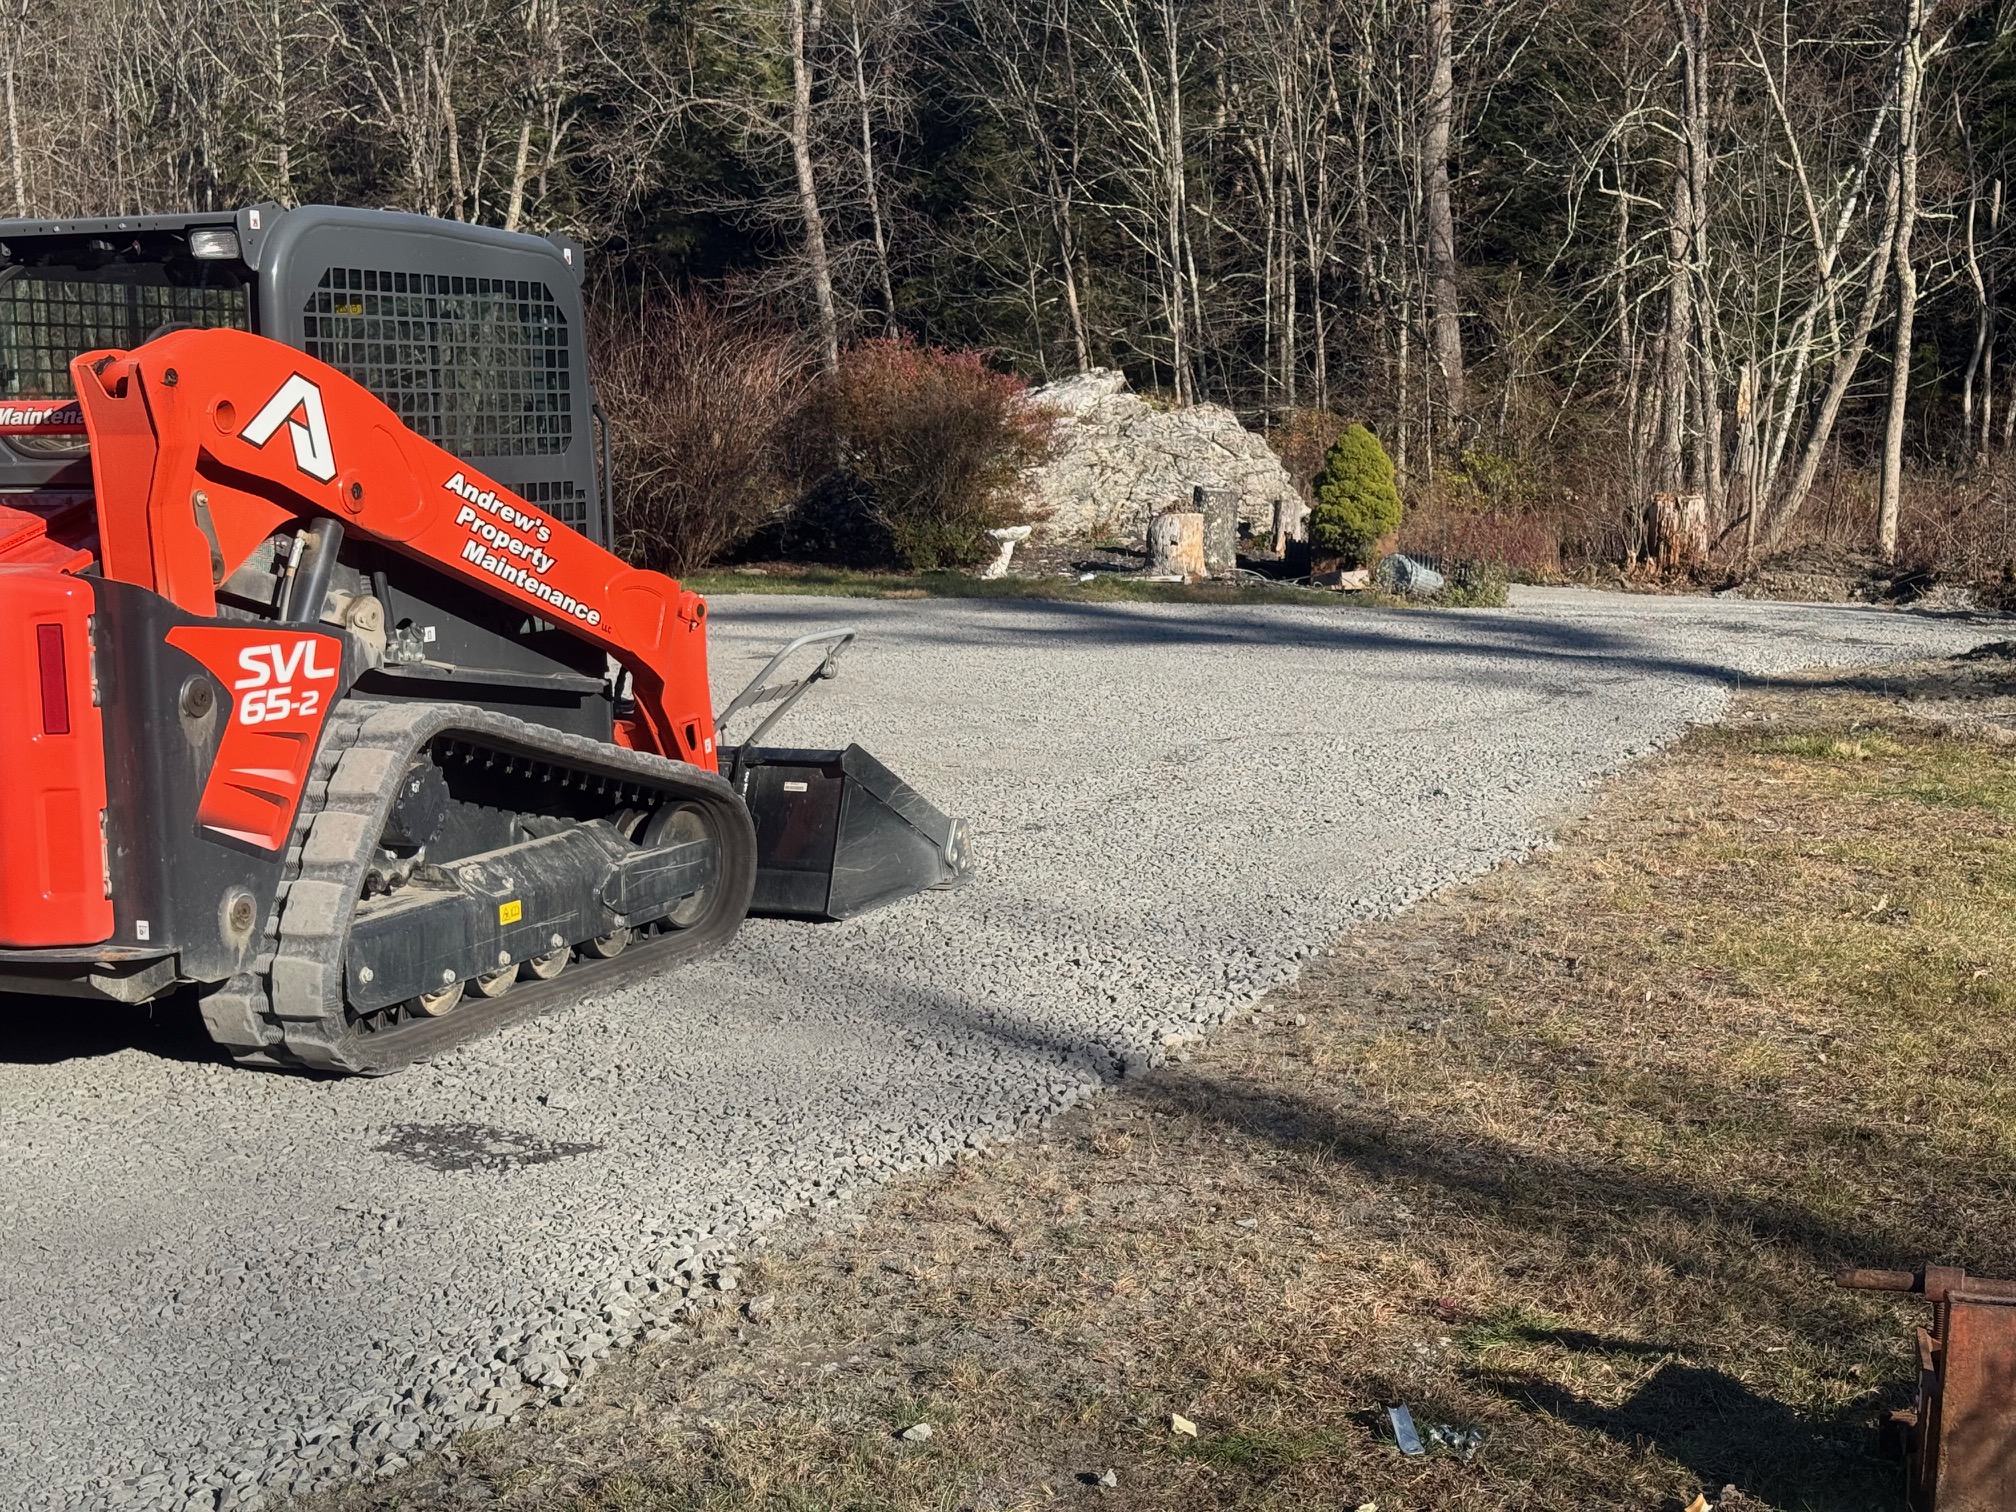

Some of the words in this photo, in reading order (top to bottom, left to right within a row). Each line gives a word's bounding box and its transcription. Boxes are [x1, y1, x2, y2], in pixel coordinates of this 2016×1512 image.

[443, 472, 551, 542] Andrew's
[456, 504, 556, 573] Property
[461, 539, 601, 625] Maintenance
[601, 622, 612, 635] LLC
[234, 640, 335, 690] SVL
[240, 686, 319, 725] 65-2
